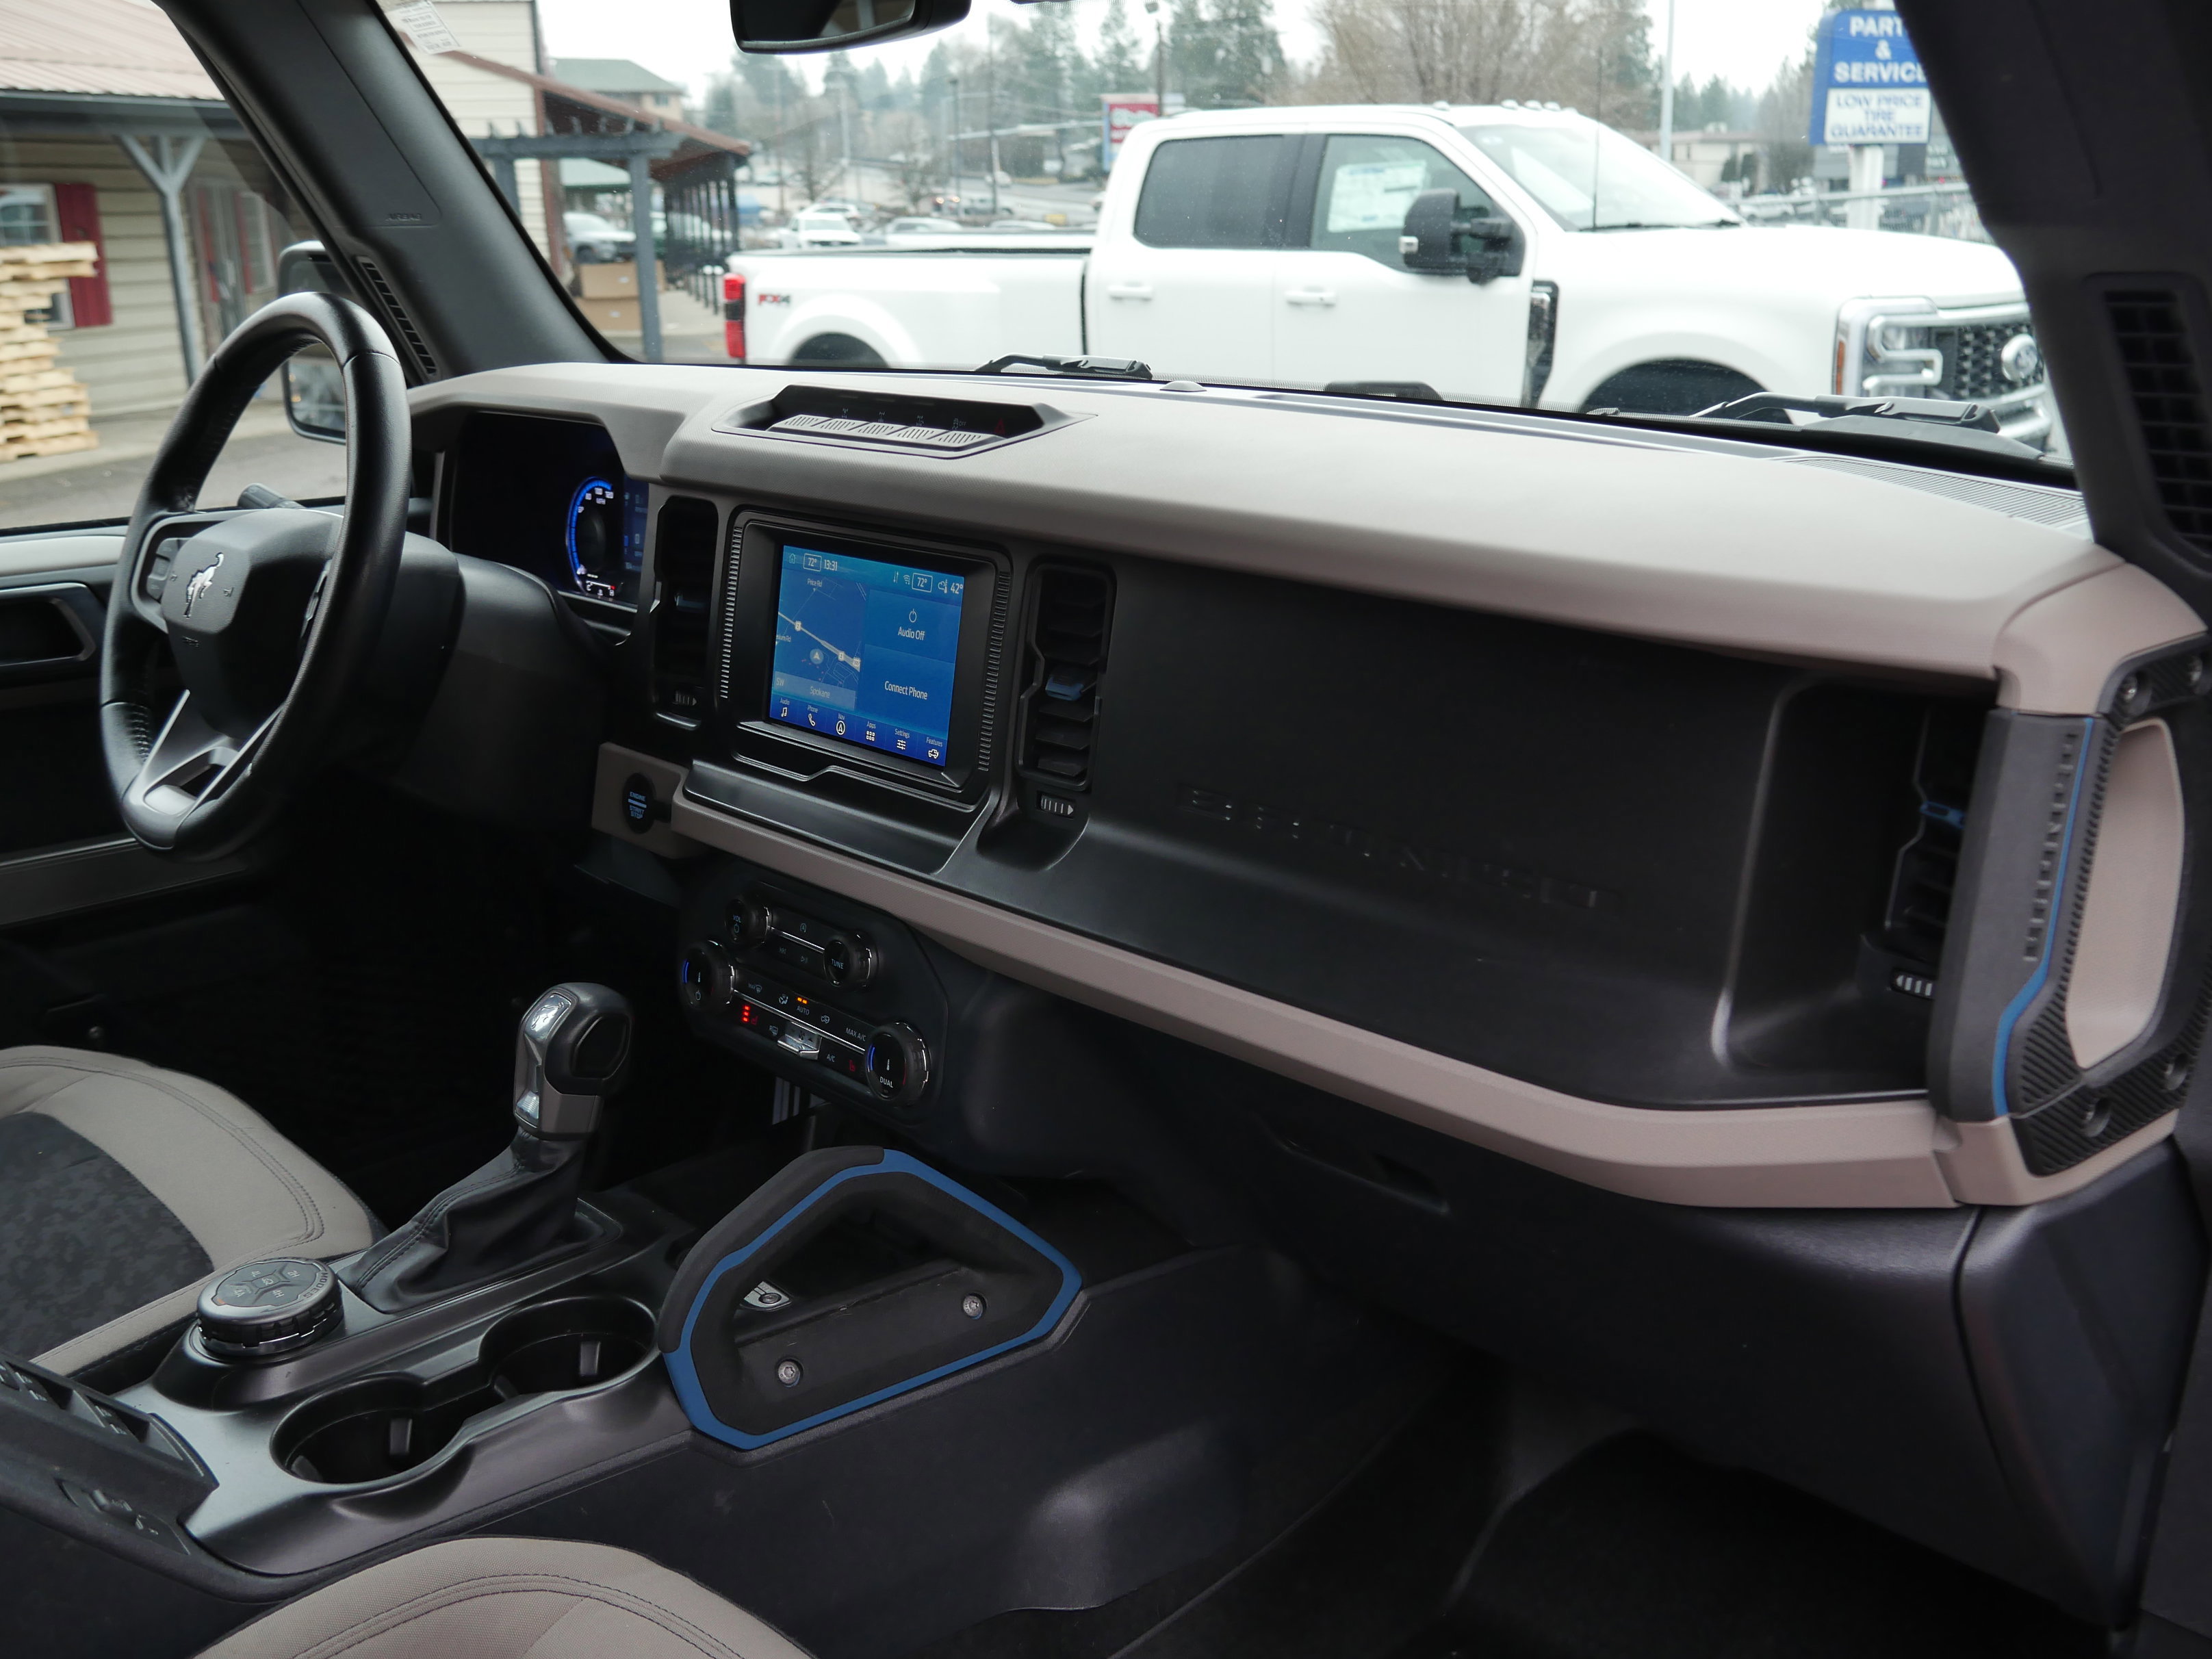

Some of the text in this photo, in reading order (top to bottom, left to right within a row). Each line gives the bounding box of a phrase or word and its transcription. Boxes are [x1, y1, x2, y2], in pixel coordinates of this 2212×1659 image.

[1875, 39, 1892, 60] &
[1836, 94, 1922, 107] LOW PRICE
[1864, 110, 1894, 122] TIRE
[1831, 125, 1923, 138] GUARANTEE
[824, 558, 838, 571] 13:31
[897, 626, 926, 641] Audio Off
[776, 678, 785, 687] SW
[810, 686, 831, 699] Spokane
[884, 680, 928, 700] Connect Phone
[780, 697, 790, 706] Audio
[807, 704, 819, 713] Phone
[866, 721, 877, 730] Apps
[895, 728, 910, 738] Settings
[926, 736, 943, 747] Features
[732, 914, 742, 923] VOL
[831, 957, 845, 970] TUNE
[796, 1005, 810, 1016] AUTO
[845, 1027, 867, 1042] MAX A/C
[826, 1053, 837, 1064] A/C
[879, 1075, 894, 1089] DUAL
[287, 1270, 300, 1278] 2H
[303, 1272, 329, 1299] MODES
[272, 1289, 285, 1298] 4H
